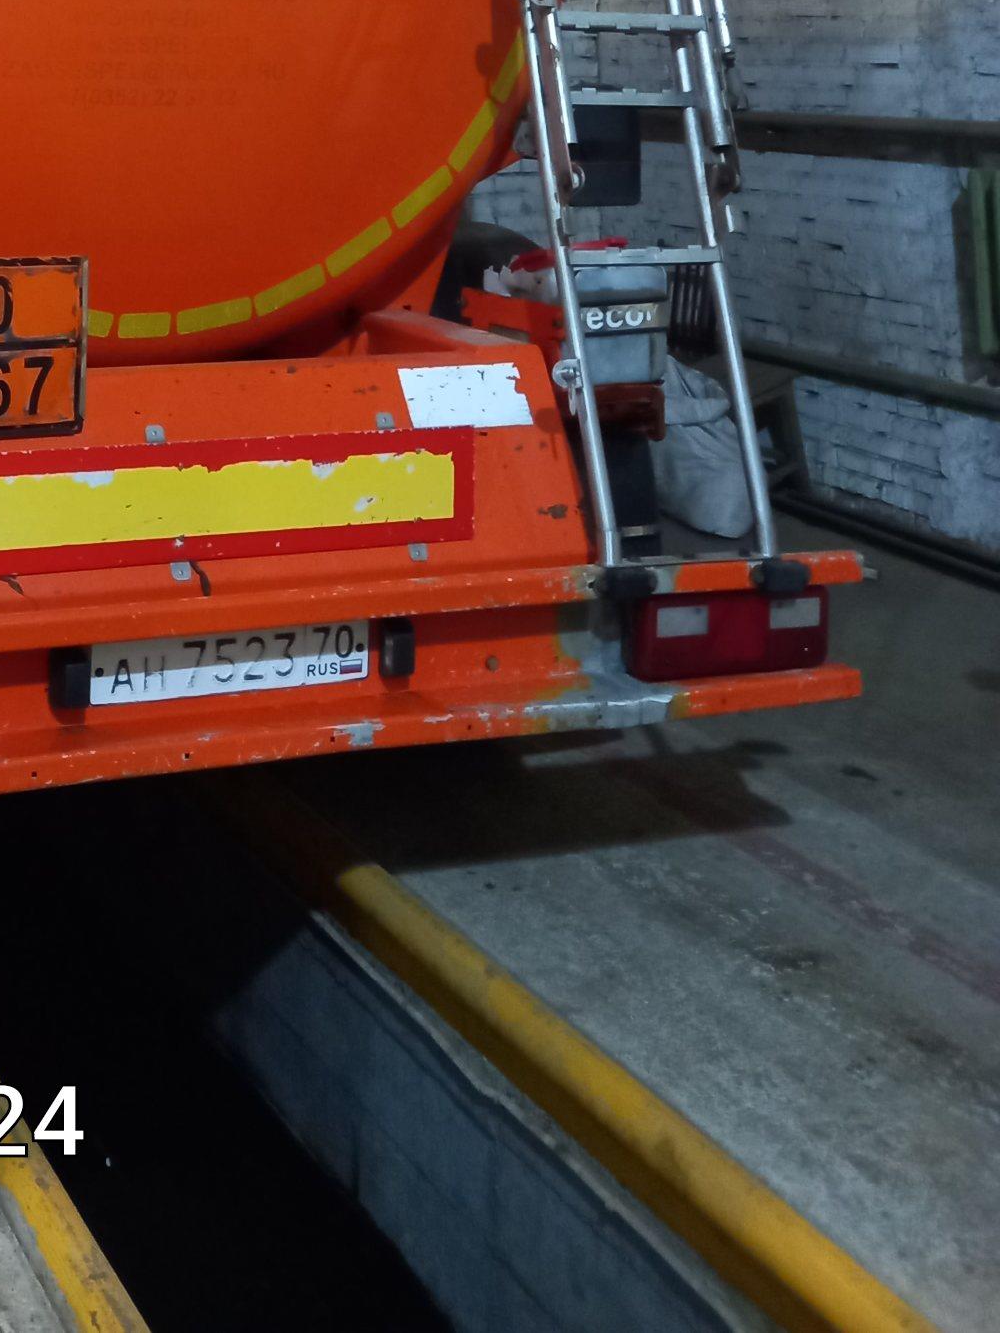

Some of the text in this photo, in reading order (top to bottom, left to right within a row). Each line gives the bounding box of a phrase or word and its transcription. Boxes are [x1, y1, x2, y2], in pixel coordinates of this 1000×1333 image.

[183, 632, 296, 689] 7523
[312, 625, 355, 661] 70
[306, 661, 338, 677] RUS
